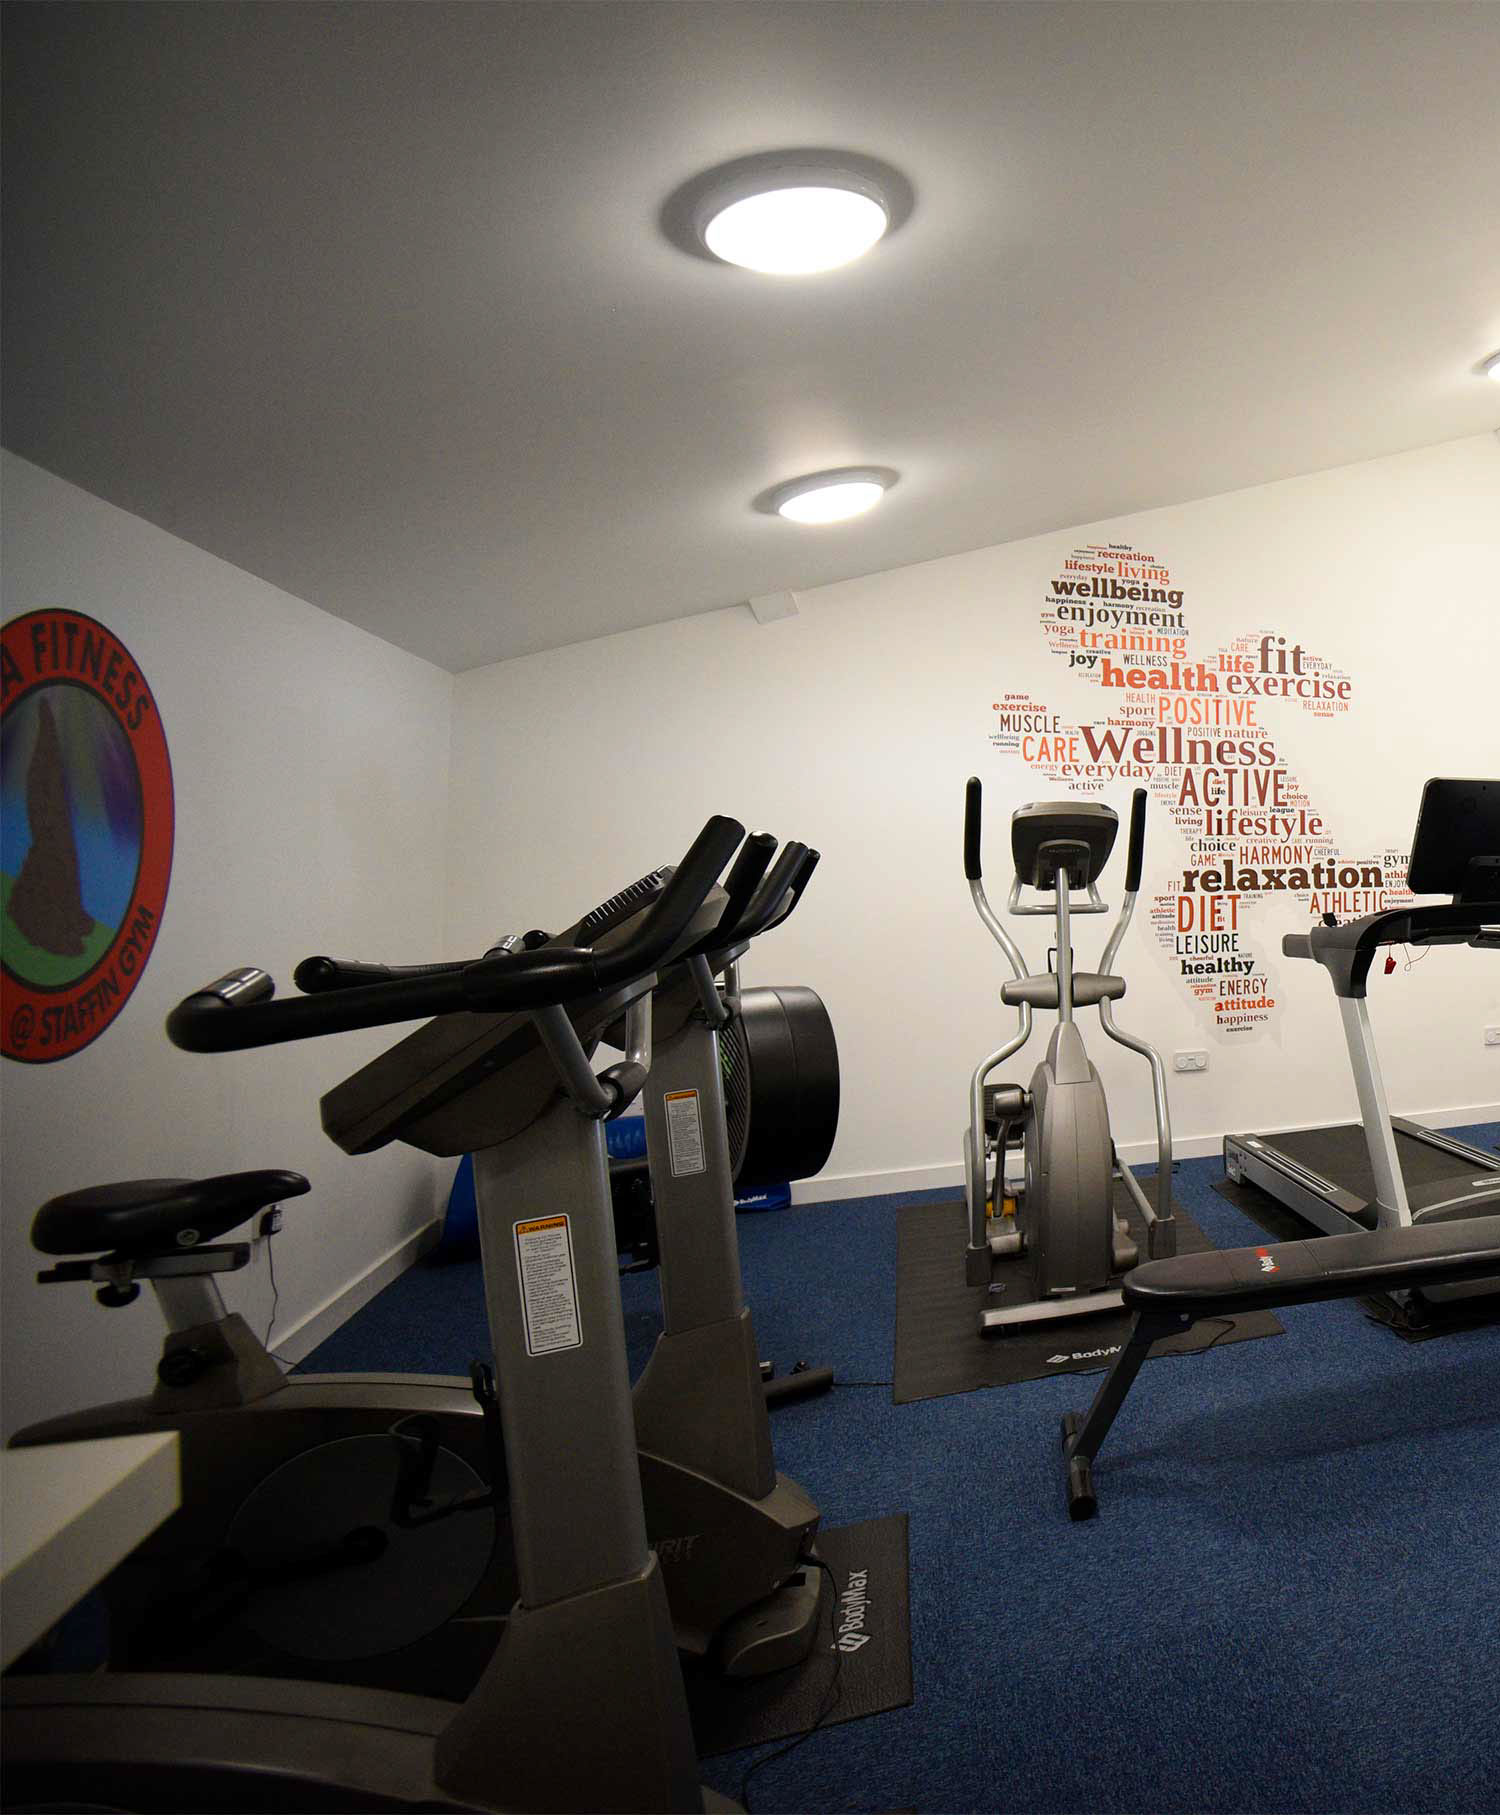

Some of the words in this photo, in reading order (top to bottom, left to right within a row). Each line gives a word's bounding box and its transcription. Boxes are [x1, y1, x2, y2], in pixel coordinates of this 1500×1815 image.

[1097, 550, 1155, 562] recreation
[1065, 560, 1114, 574] lifestyle
[1118, 561, 1170, 585] living
[1051, 578, 1184, 608] wellbeing
[1046, 596, 1086, 605] happiness
[1104, 602, 1134, 610] harmony
[1057, 602, 1184, 629] enjoyment
[1044, 625, 1074, 636] yoga
[1157, 628, 1189, 636] MEDITATION
[1080, 629, 1186, 659] training
[1231, 643, 1248, 652] CARE
[1069, 650, 1097, 668] joy
[1123, 654, 1168, 666] WELLNESS
[1258, 636, 1306, 676] fit
[1218, 654, 1255, 673] life
[1303, 662, 1332, 670] EVERYDAY
[30, 621, 150, 731] FITNESS
[1101, 658, 1219, 691] health
[1227, 672, 1351, 700] exercise
[1126, 693, 1155, 704] HEALTH
[1303, 700, 1348, 711] RELAXATION
[992, 703, 1046, 712] exercise
[1120, 705, 1155, 718] sport
[1158, 696, 1257, 726] POSITIVE
[1000, 714, 1060, 733] MUSCLE
[1107, 717, 1155, 729] harmony
[1188, 727, 1220, 737] POSITIVE
[1224, 728, 1268, 738] nature
[1023, 736, 1080, 762] CARE
[1078, 726, 1276, 766] Wellness
[1062, 760, 1155, 782] everyday
[1165, 766, 1183, 777] DIET
[1068, 780, 1104, 791] active
[1179, 768, 1287, 806] ACTIVE
[1211, 787, 1225, 795] life
[1169, 807, 1202, 815] sense
[1240, 808, 1267, 816] leisure
[1175, 817, 1202, 826] living
[1205, 809, 1322, 843] lifestyle
[1191, 839, 1236, 852] choice
[1191, 854, 1216, 866] GAME
[1240, 846, 1313, 864] HARMONY
[1183, 858, 1384, 892] relaxation
[1168, 881, 1181, 891] FIT
[1310, 891, 1387, 914] ATHLETIC
[1178, 894, 1241, 932] DIET
[1176, 933, 1239, 954] LEISURE
[1181, 958, 1255, 975] healthy
[10, 1004, 35, 1049] @
[41, 966, 121, 1045] STAFFIN
[118, 904, 155, 977] GYM
[1194, 988, 1213, 996] gym
[1220, 978, 1267, 996] ENERGY
[1214, 996, 1275, 1012] attitude
[1217, 1014, 1268, 1025] happiness
[529, 1221, 565, 1233] WARNING
[1072, 1345, 1122, 1360] BodyM
[838, 1568, 872, 1634] BodyMax
